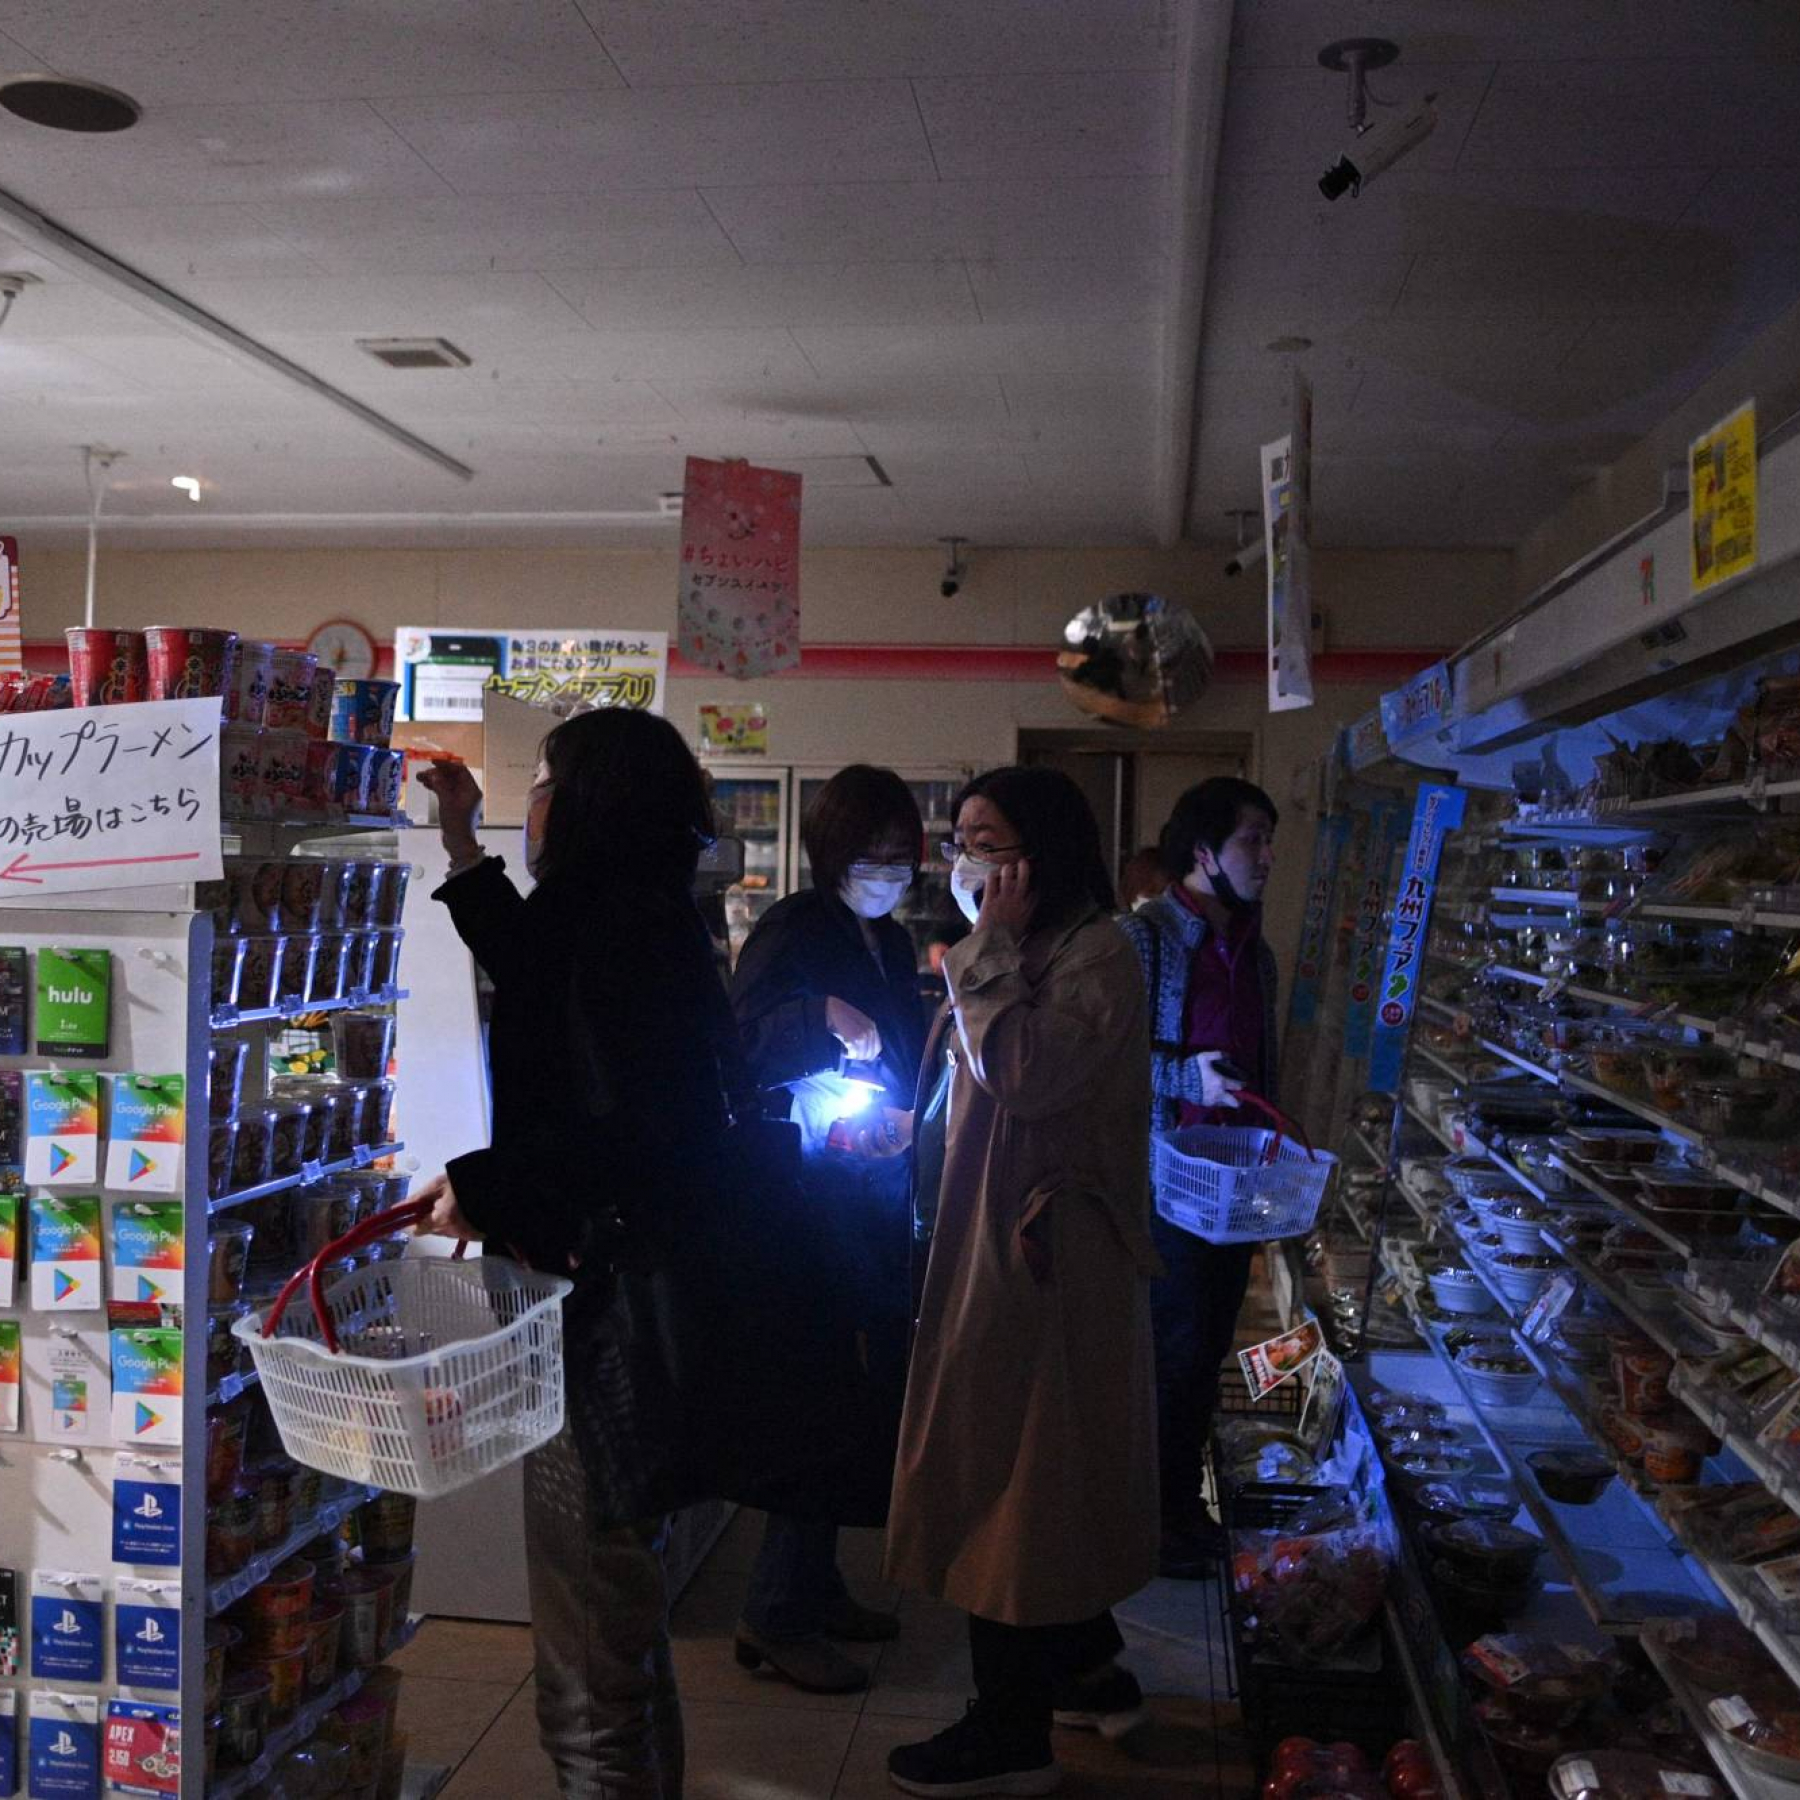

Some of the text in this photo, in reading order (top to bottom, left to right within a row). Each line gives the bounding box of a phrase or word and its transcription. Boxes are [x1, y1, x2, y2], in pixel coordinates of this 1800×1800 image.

[0, 718, 214, 781] カップラーメン
[0, 787, 201, 846] の売場はこちら
[1394, 876, 1427, 972] 九州フェア
[47, 984, 94, 1005] hulu
[32, 1097, 93, 1113] Google Play
[115, 1102, 179, 1117] Google Play
[34, 1223, 72, 1238] Google
[118, 1228, 158, 1243] Google
[117, 1354, 156, 1370] Google
[108, 1723, 135, 1743] APEX
